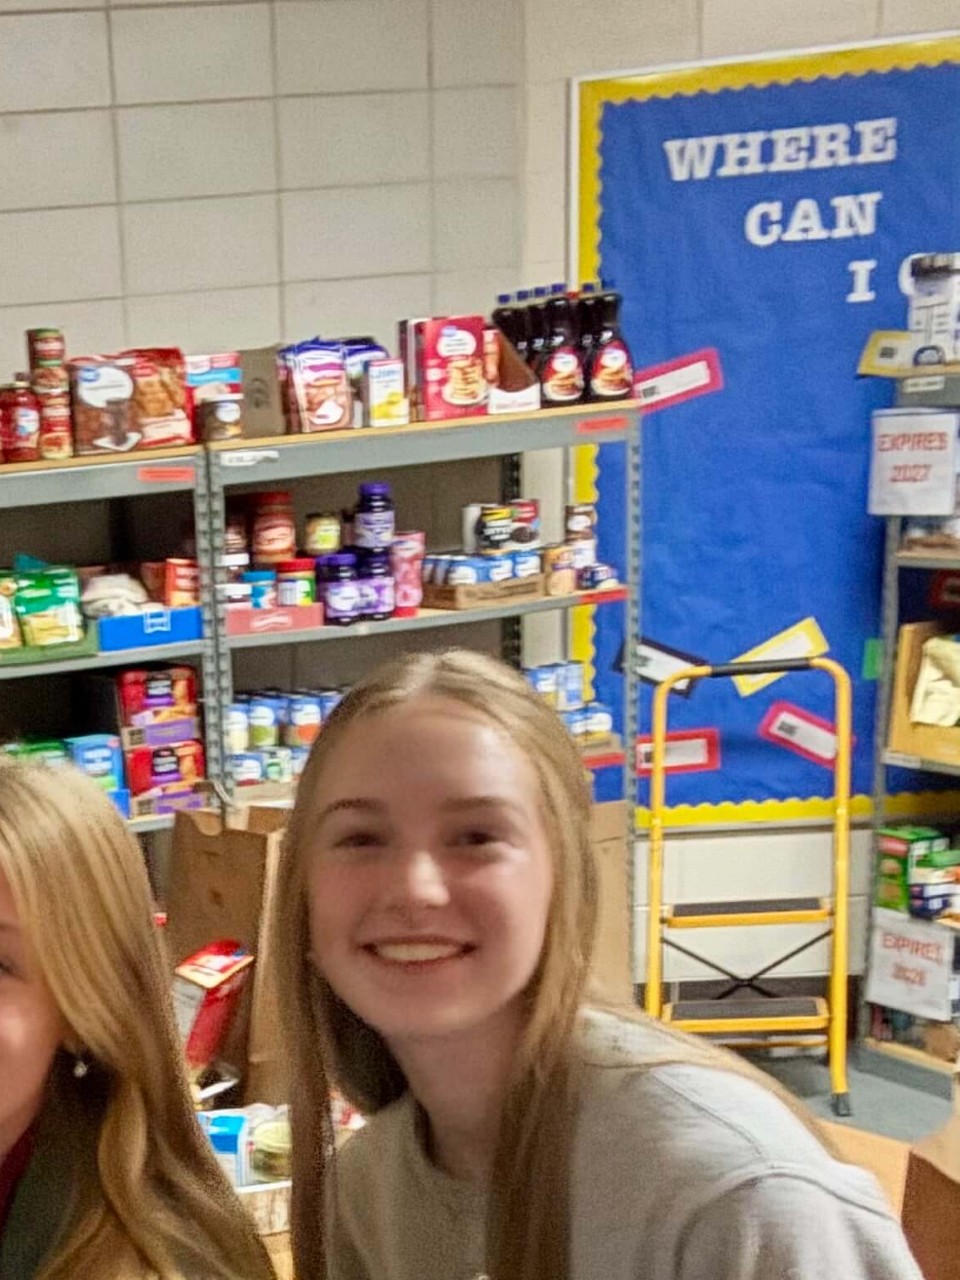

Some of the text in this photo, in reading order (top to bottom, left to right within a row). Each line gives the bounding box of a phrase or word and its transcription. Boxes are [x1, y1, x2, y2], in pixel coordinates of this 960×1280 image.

[662, 117, 898, 182] WHERE
[744, 191, 883, 246] CAN
[845, 259, 878, 303] I
[877, 431, 948, 452] EXPIRES
